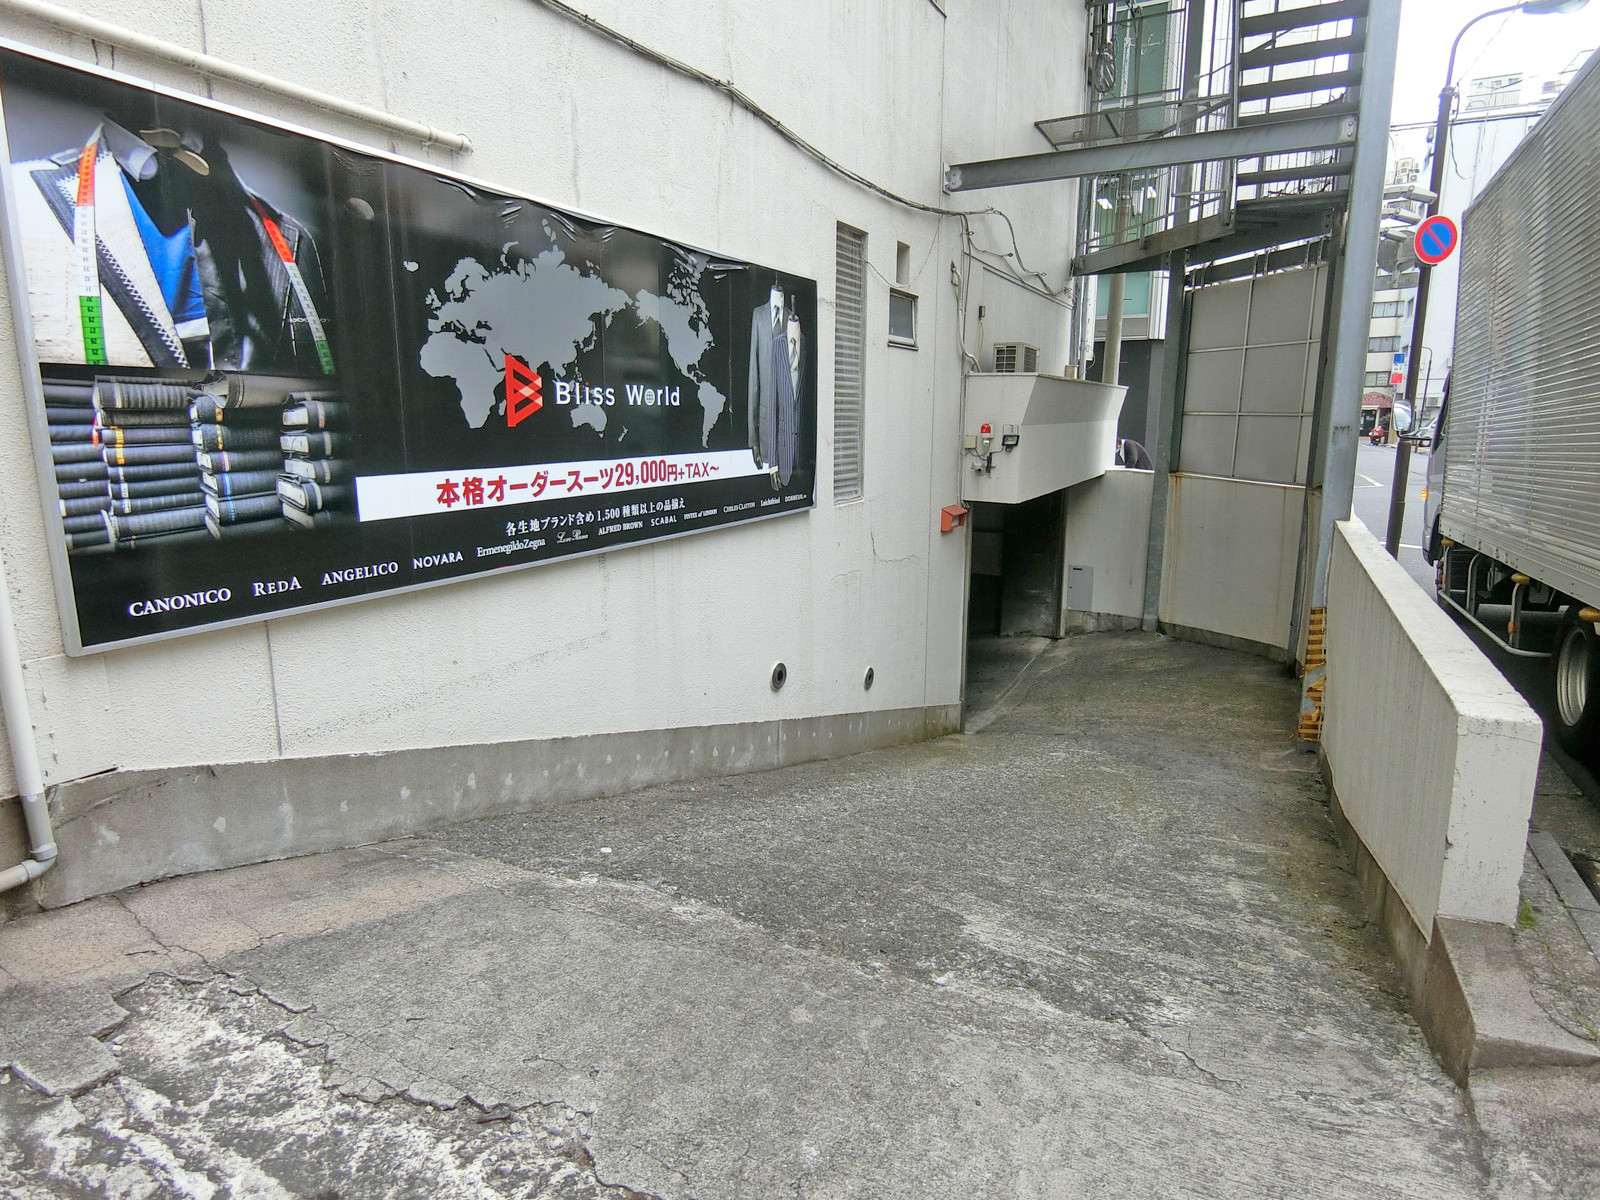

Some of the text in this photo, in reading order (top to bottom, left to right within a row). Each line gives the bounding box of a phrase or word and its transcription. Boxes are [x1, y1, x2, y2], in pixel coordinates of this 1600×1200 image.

[554, 381, 681, 406] Bliss World
[598, 520, 644, 536] ALFRED BROWN
[650, 514, 678, 527] SCABAL
[413, 551, 464, 570] NOVARA
[321, 561, 399, 586] ANGELICO
[128, 587, 232, 617] CANONICO
